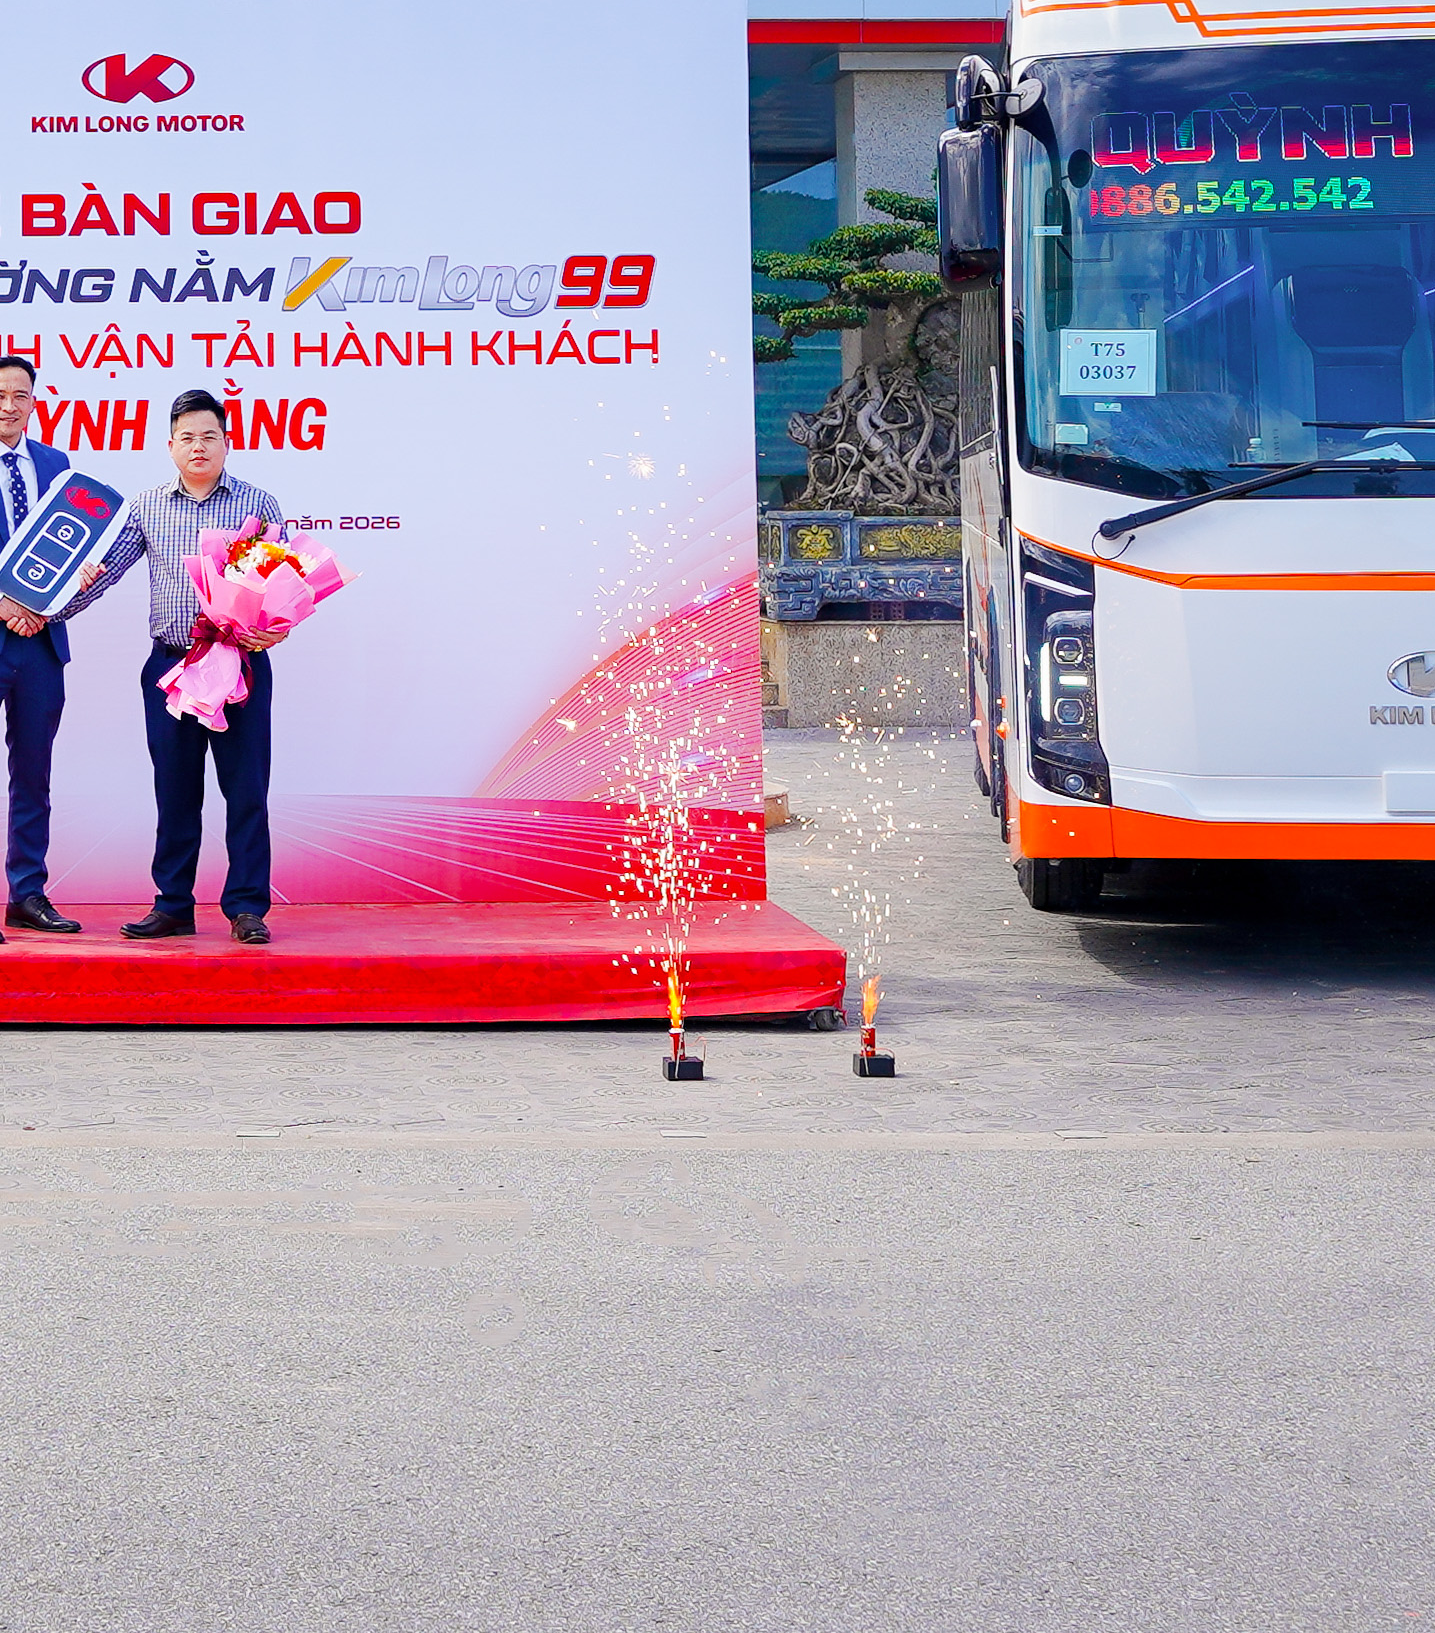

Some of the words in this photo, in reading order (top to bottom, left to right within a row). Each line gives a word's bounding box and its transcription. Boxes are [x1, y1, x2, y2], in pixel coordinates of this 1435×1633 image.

[31, 115, 79, 133] KIM
[85, 115, 149, 133] LONG
[156, 114, 245, 132] MOTOR
[1090, 91, 1414, 175] QUỲNH
[21, 182, 171, 237] BÀN
[192, 191, 361, 235] GIAO
[128, 249, 274, 304] NẰM
[59, 322, 174, 379] VẬN
[191, 319, 275, 369] TẢI
[293, 321, 452, 368] HÀNH
[470, 319, 659, 366] KHÁCH
[1090, 343, 1126, 357] T75
[1079, 365, 1137, 380] 03037
[222, 377, 328, 451] ẰNG
[339, 516, 401, 530] 2026
[1369, 705, 1424, 725] KIM
